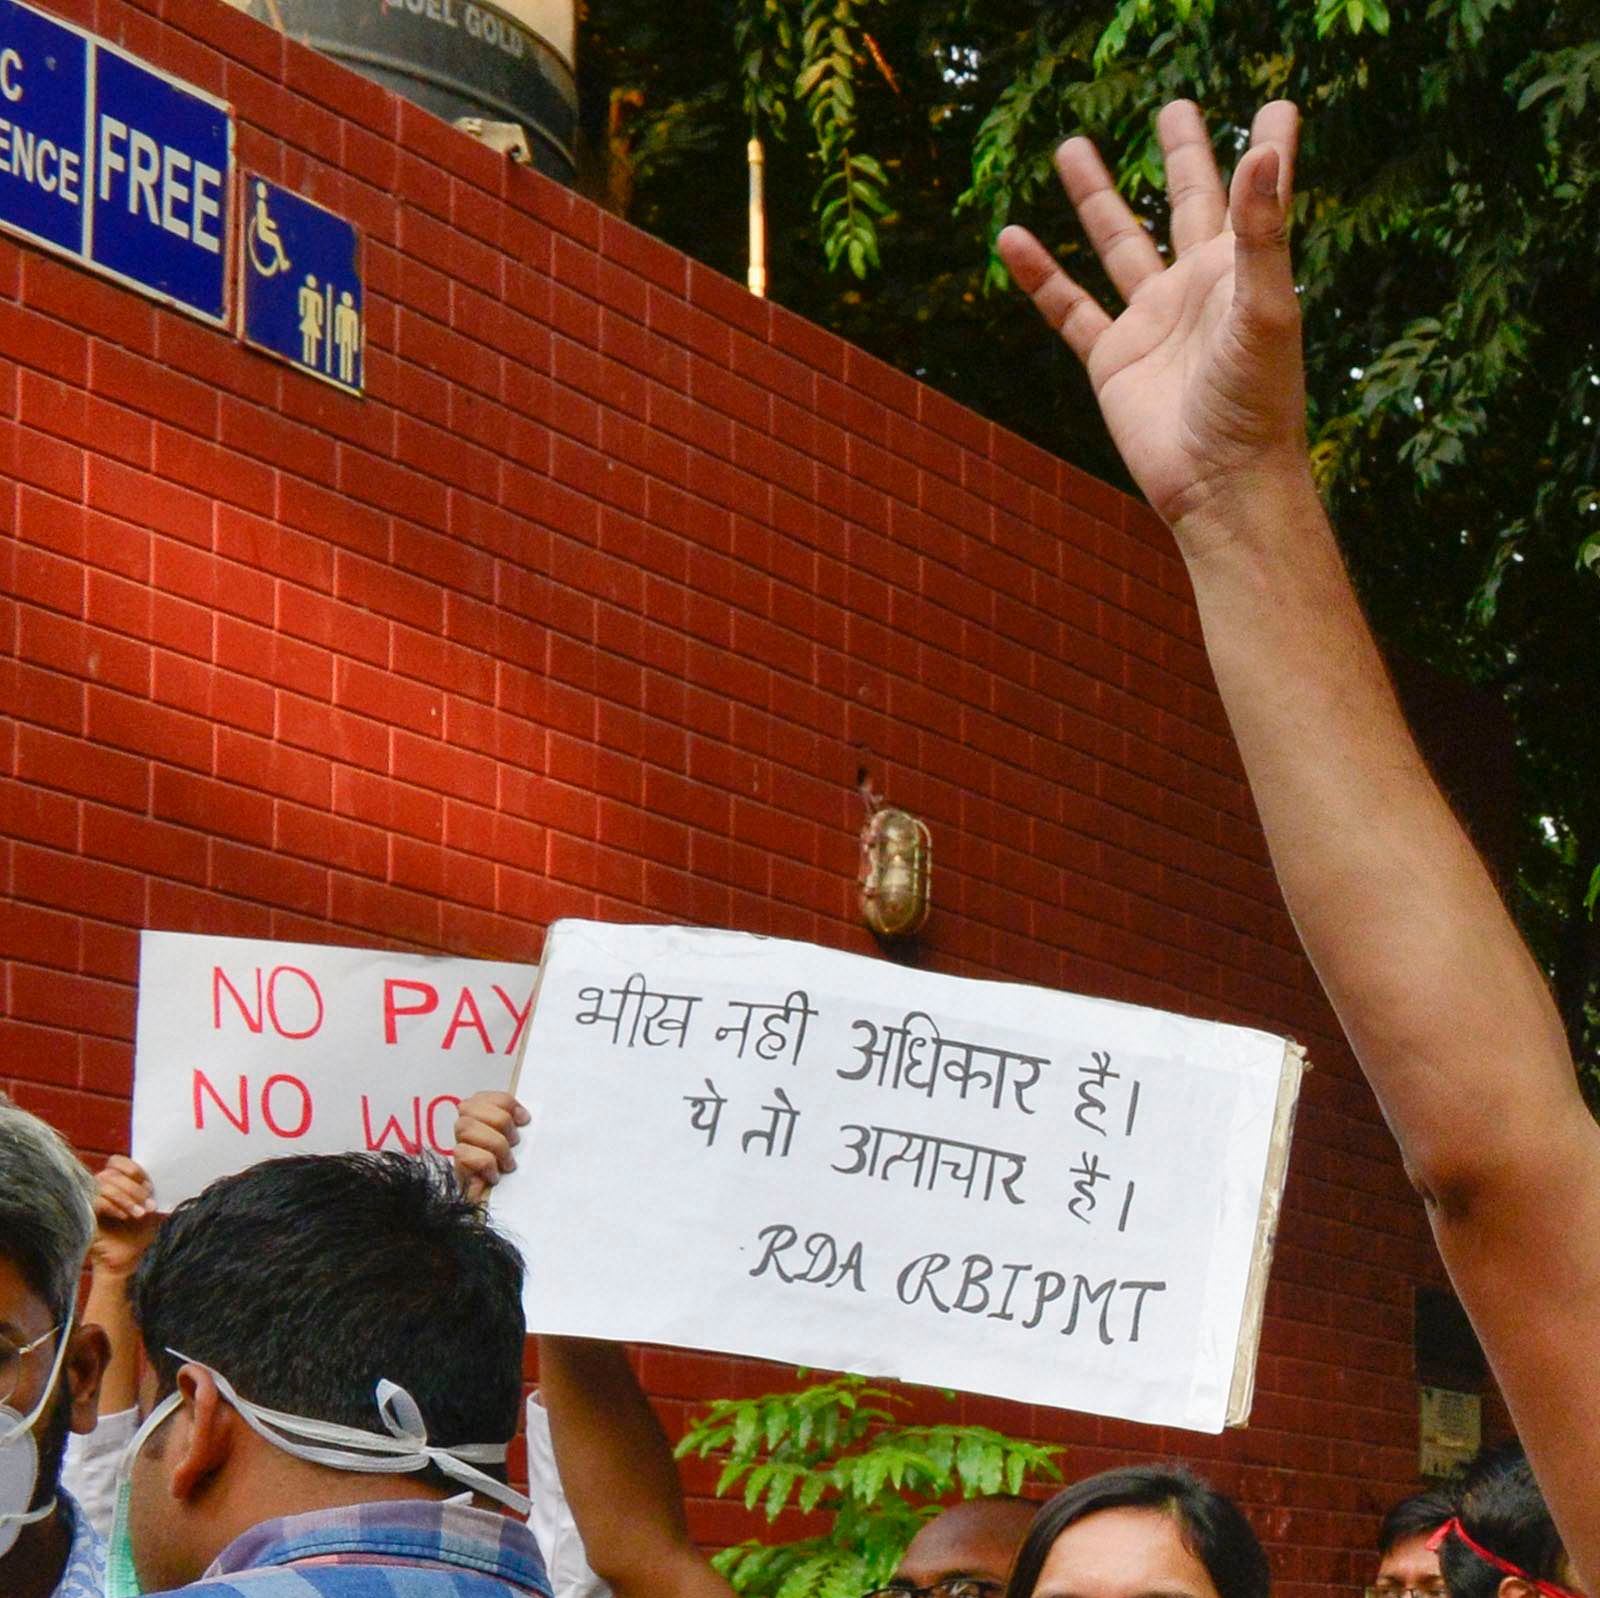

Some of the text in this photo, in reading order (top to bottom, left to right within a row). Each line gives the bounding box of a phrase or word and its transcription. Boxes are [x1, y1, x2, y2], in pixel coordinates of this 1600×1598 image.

[100, 113, 221, 254] FREE
[212, 964, 536, 1056] NO PAY
[575, 972, 702, 1049] भीख
[715, 990, 819, 1067] नही
[836, 1011, 1052, 1115] अधिकार
[193, 1068, 463, 1157] NO WO
[683, 1077, 728, 1148] ये
[741, 1087, 801, 1158] तो
[830, 1123, 1027, 1206] अत्याचार
[748, 1223, 1168, 1346] RDA RBIPMT
